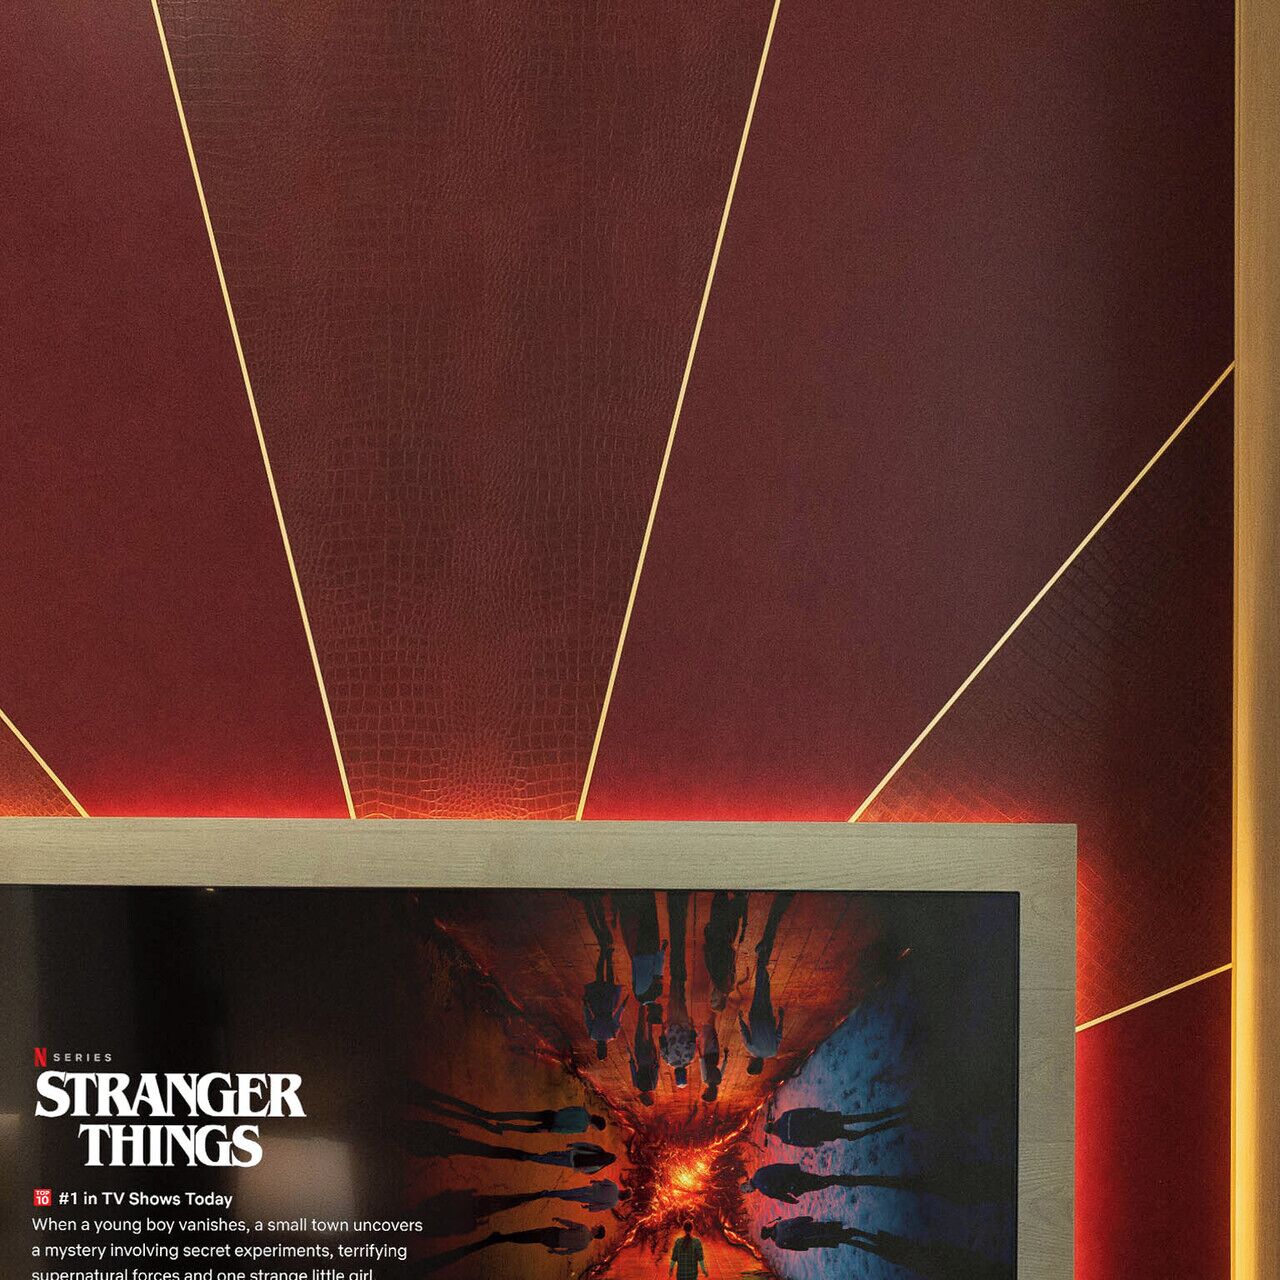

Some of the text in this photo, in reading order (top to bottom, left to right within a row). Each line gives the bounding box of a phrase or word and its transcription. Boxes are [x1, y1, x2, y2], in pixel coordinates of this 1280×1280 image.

[34, 1047, 113, 1067] N SERIES
[34, 1070, 308, 1118] STRANGER
[77, 1123, 263, 1168] THINGS
[36, 1195, 49, 1205] 10
[58, 1191, 233, 1209] #1 in TV Shows Today
[31, 1217, 423, 1236] When a young boy vanishes, a small town uncovers
[31, 1243, 407, 1261] a mystery involving secret experiments, terrifying
